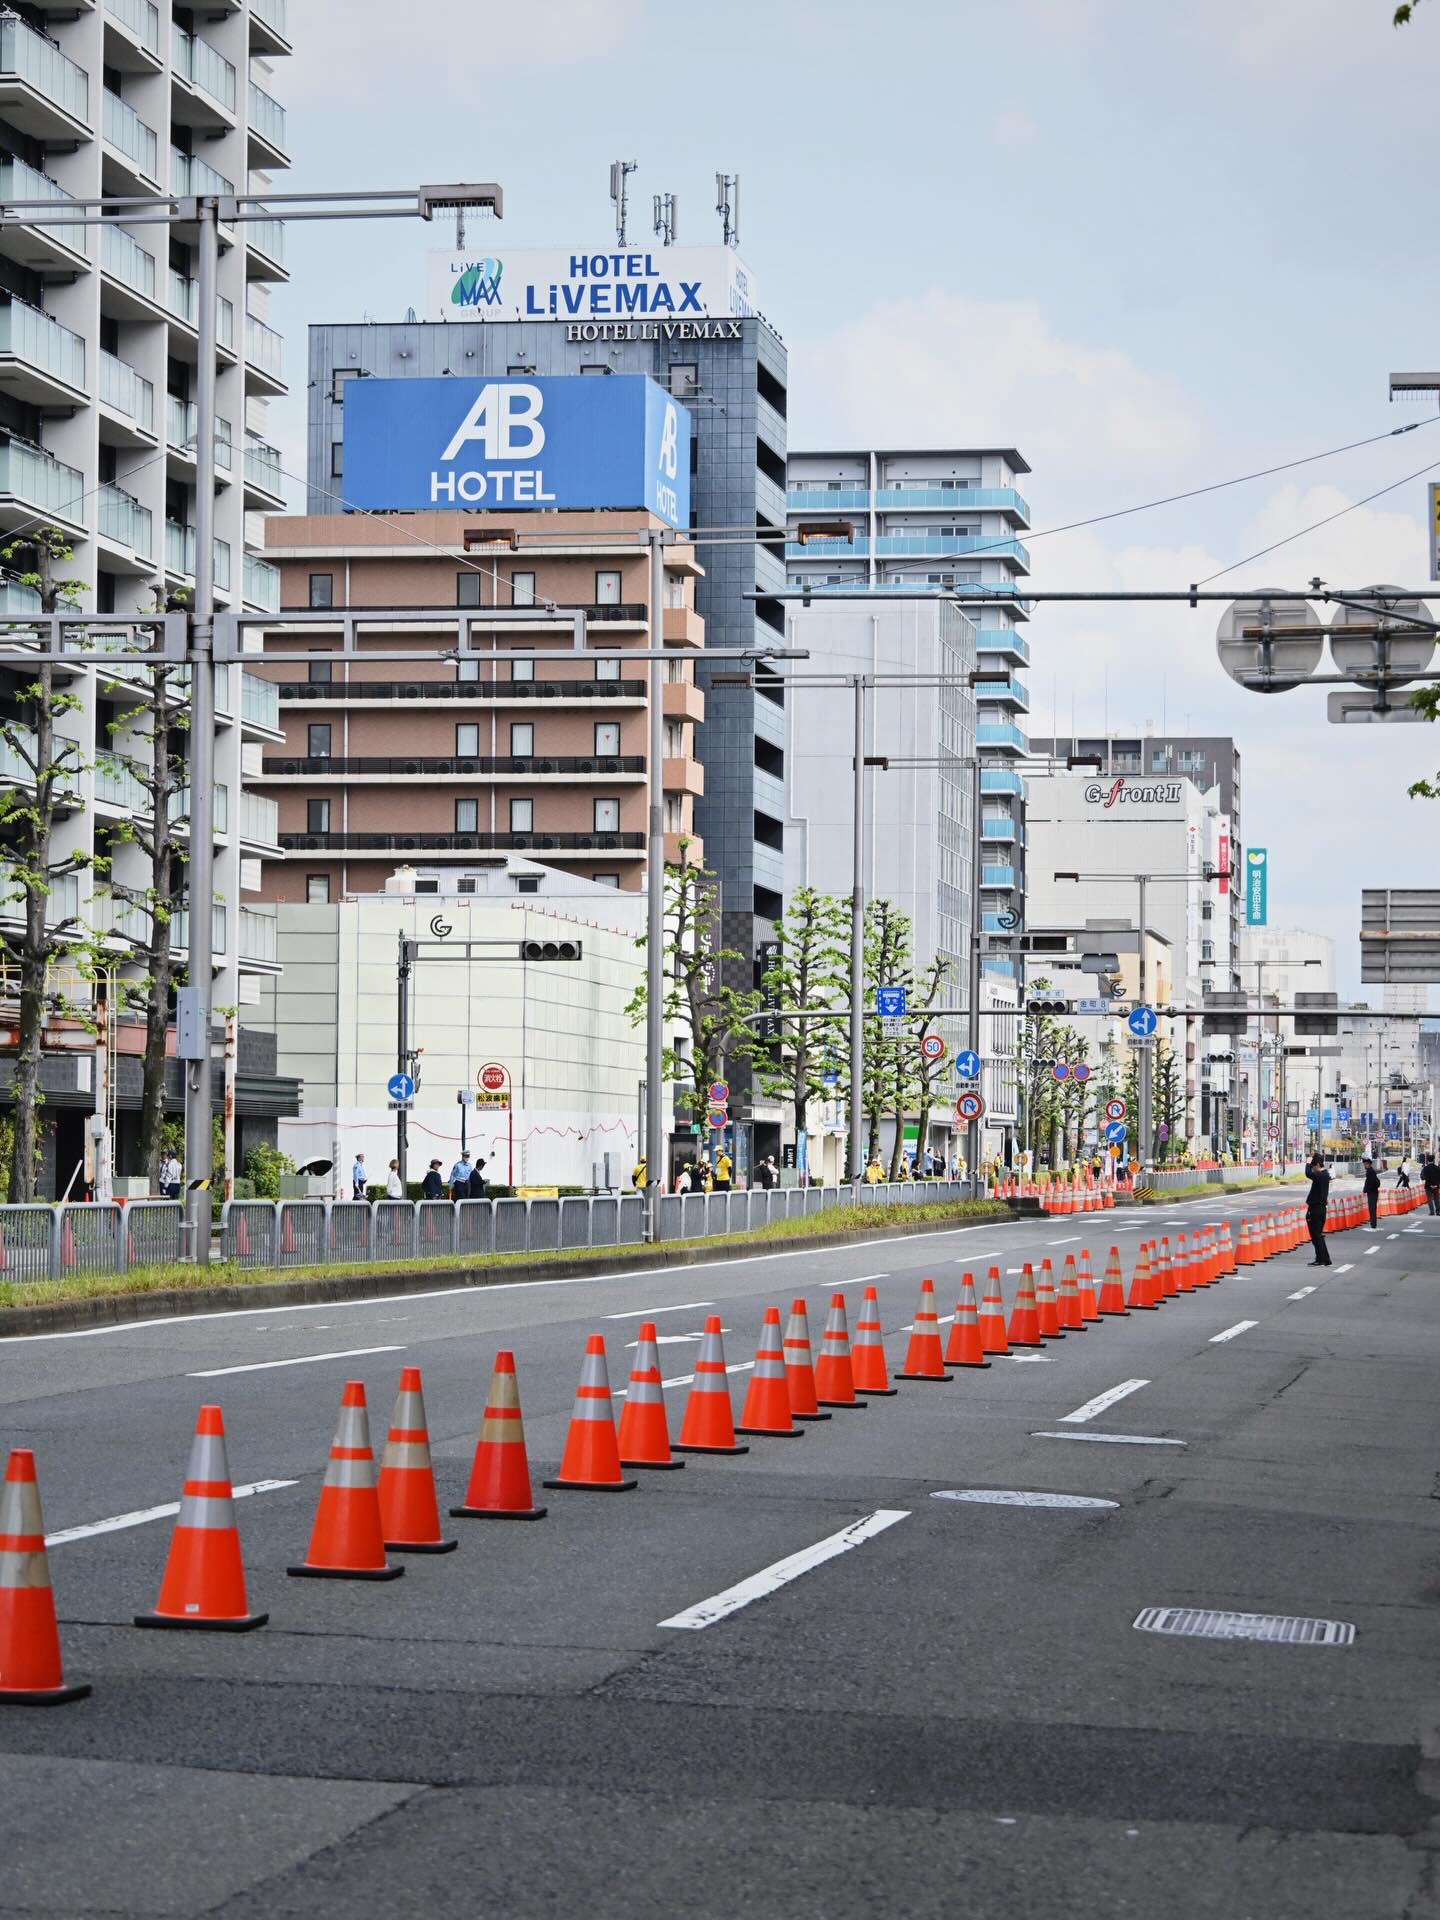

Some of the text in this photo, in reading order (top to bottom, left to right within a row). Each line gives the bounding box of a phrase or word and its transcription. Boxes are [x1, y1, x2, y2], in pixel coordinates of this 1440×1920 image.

[451, 262, 485, 272] LiVE
[570, 254, 659, 278] HOTEL
[460, 276, 502, 306] MAX
[526, 282, 703, 314] LiVEMAX
[567, 322, 743, 341] HOTEL LiVEMAX
[440, 384, 546, 460] AB
[659, 401, 677, 480] AB
[431, 470, 556, 502] HOTEL
[657, 480, 678, 523] HOTEL
[927, 1041, 939, 1052] 50
